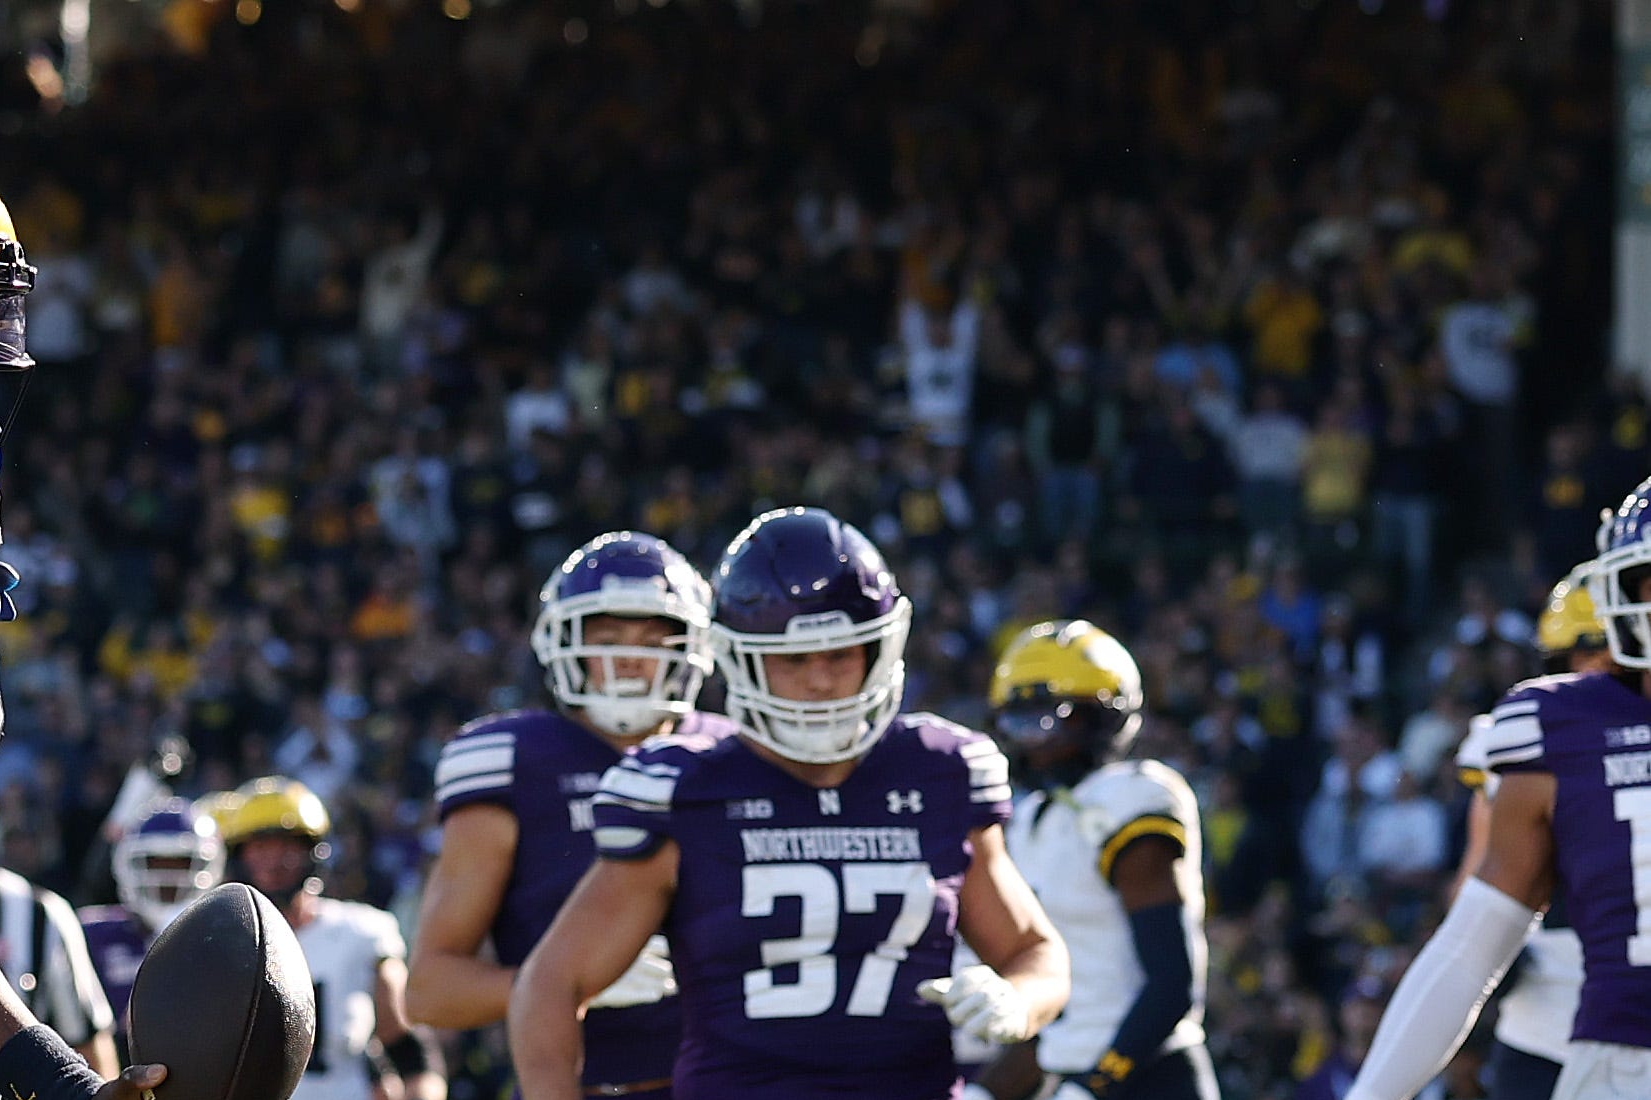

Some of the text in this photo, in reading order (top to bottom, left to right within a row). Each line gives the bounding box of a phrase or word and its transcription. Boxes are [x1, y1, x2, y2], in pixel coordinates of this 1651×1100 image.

[817, 788, 842, 816] N
[740, 826, 922, 861] NORTHWESTERN
[742, 862, 935, 1019] 37
